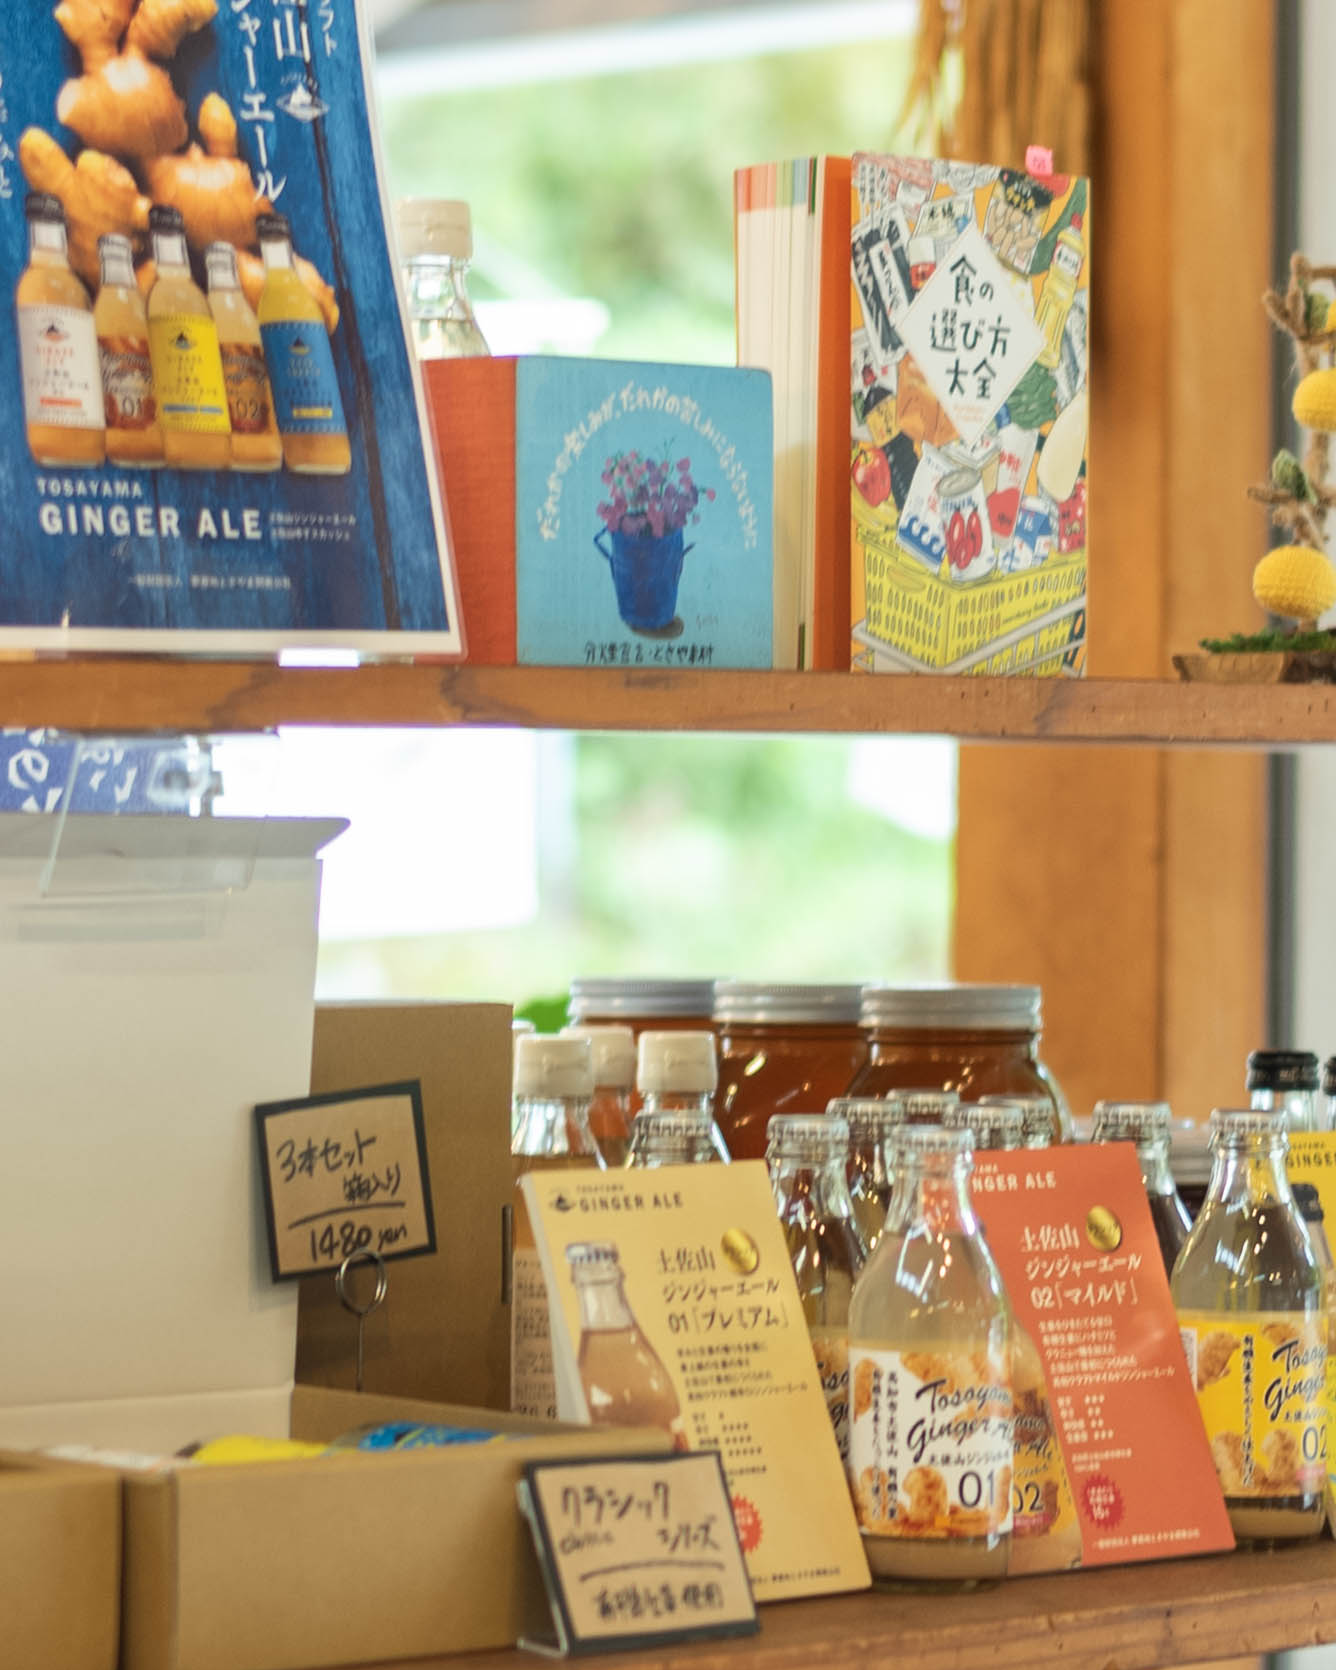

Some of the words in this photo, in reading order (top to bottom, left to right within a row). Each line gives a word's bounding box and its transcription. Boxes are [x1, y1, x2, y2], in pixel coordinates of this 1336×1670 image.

[949, 254, 995, 306] 食の
[930, 306, 1012, 358] 選び方
[945, 357, 997, 401] 大全
[37, 478, 144, 499] TOSAYAMA
[40, 503, 182, 538] GINGER
[197, 508, 263, 540] ALE
[972, 1172, 1018, 1193] NGER
[1025, 1170, 1057, 1190] ALE
[579, 1193, 646, 1213] GINGER
[652, 1190, 685, 1210] ALE
[310, 1220, 373, 1263] 1480
[1025, 1253, 1143, 1281] ジンジャーエール
[663, 1278, 781, 1304] ジンジャーエール
[906, 1416, 991, 1465] Ginger
[958, 1469, 995, 1509] 01
